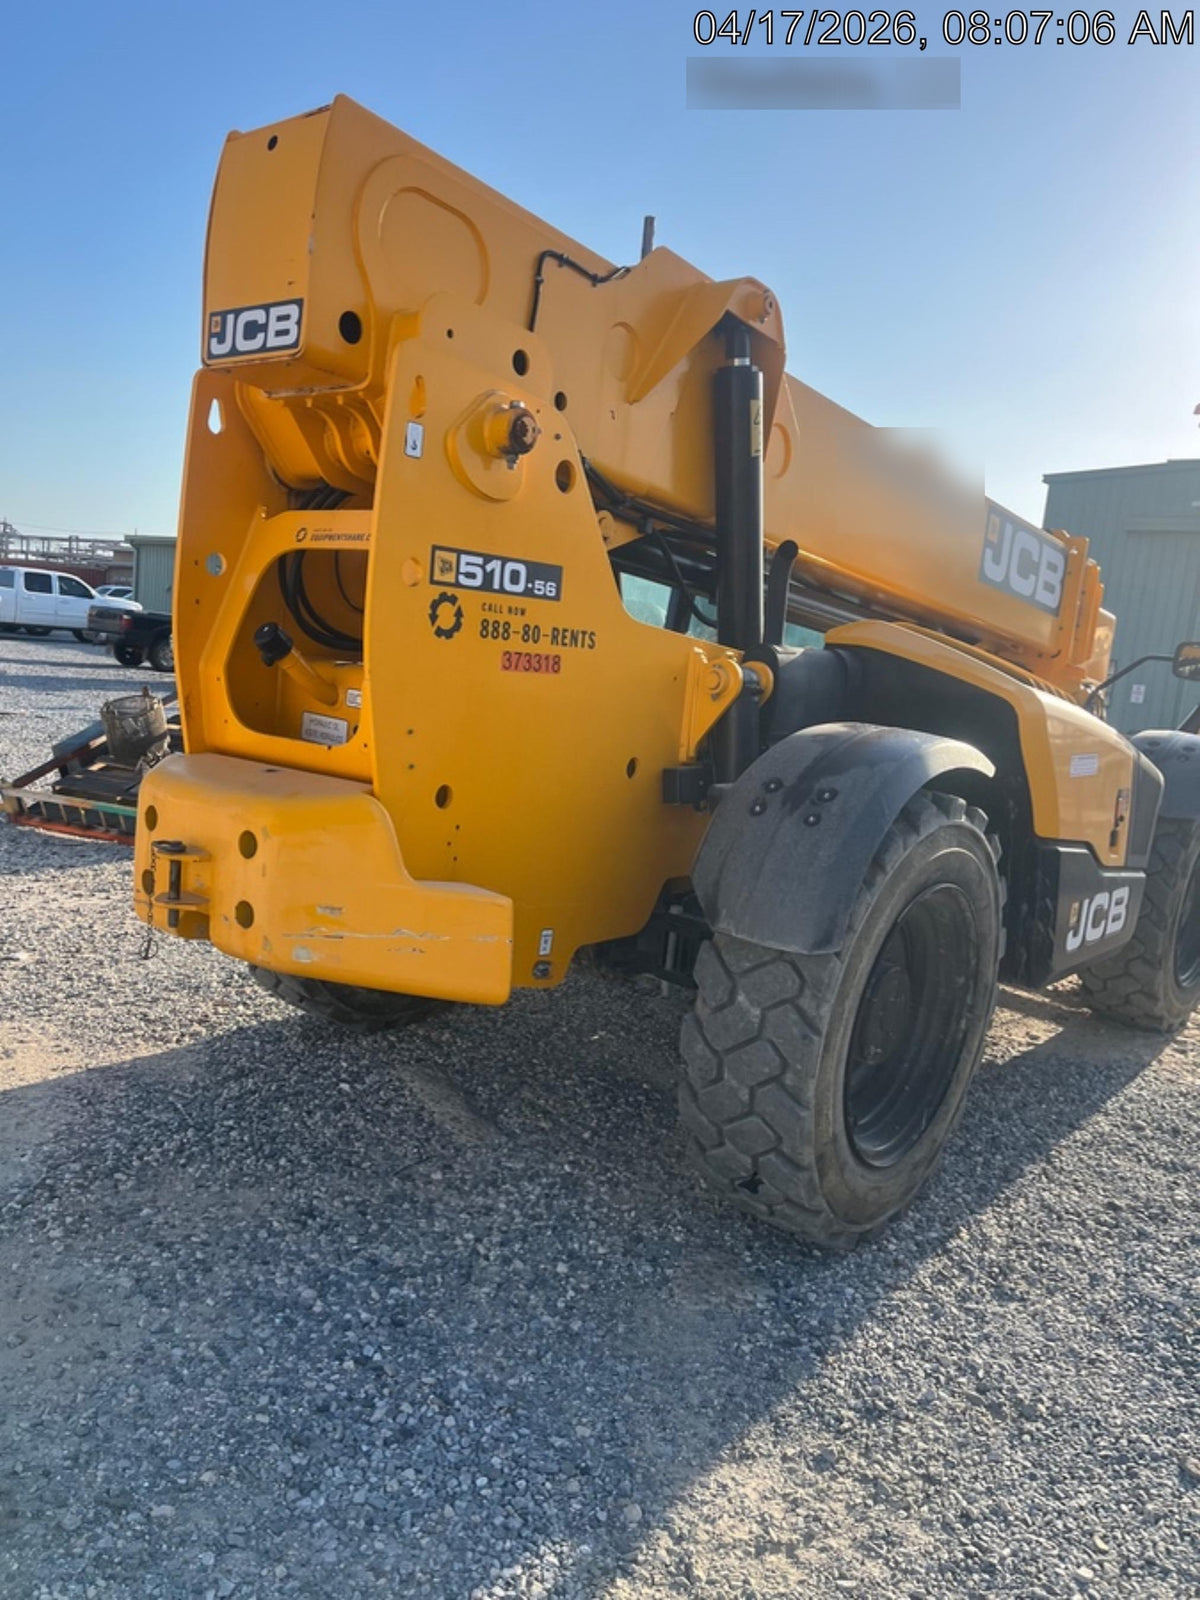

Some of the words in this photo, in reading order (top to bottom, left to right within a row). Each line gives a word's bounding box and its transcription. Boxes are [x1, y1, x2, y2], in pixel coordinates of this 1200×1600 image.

[210, 303, 300, 355] JCB
[983, 521, 1065, 609] JCB
[481, 602, 503, 614] CALL
[508, 605, 527, 616] NOW
[479, 618, 597, 650] 888-80-RENTS
[502, 650, 561, 674] 373318
[1066, 886, 1130, 951] JCB
